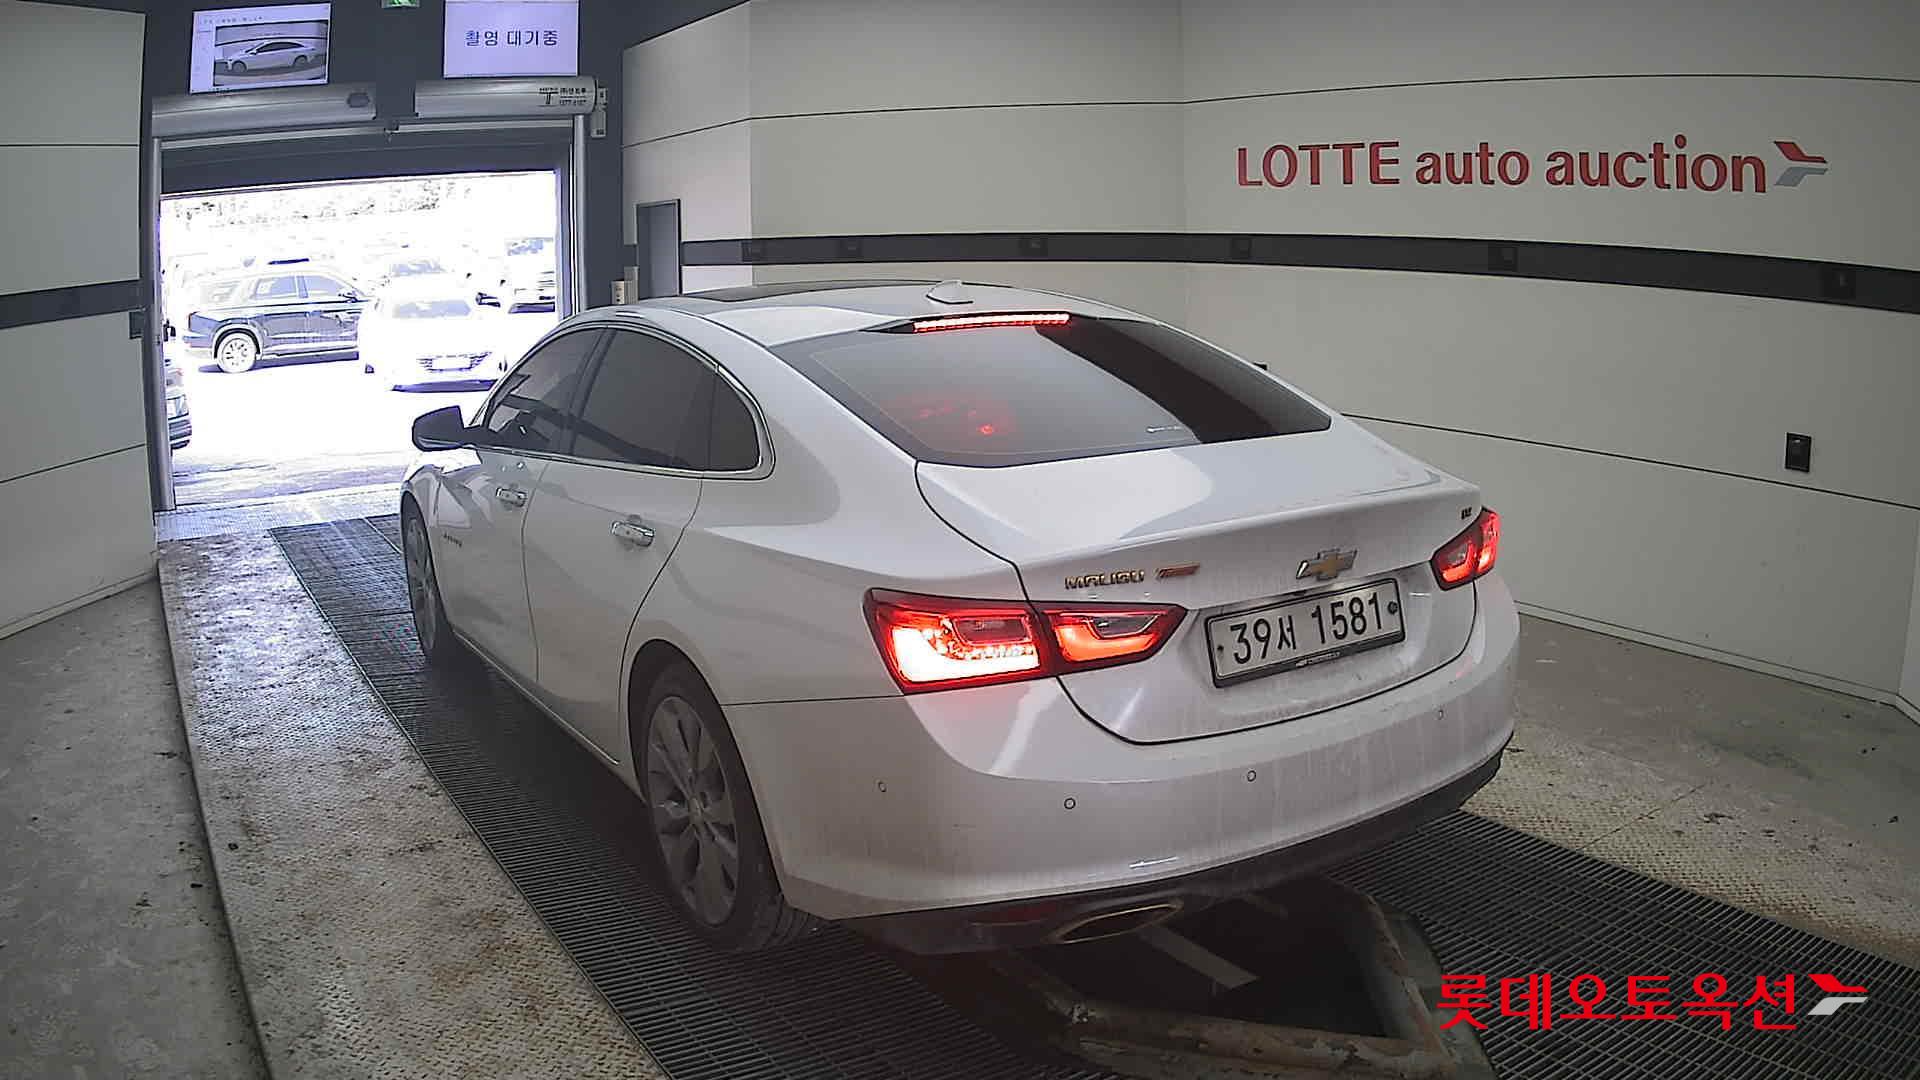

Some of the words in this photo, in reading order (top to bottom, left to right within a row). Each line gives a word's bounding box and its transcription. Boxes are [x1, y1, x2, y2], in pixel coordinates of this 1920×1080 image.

[466, 30, 498, 46] 촬영
[507, 30, 558, 46] 대기중
[1237, 141, 1399, 187] LOTTE
[1416, 141, 1530, 186] auto
[1546, 134, 1767, 193] auction
[1230, 614, 1297, 664] 39서
[1311, 591, 1382, 645] 1581
